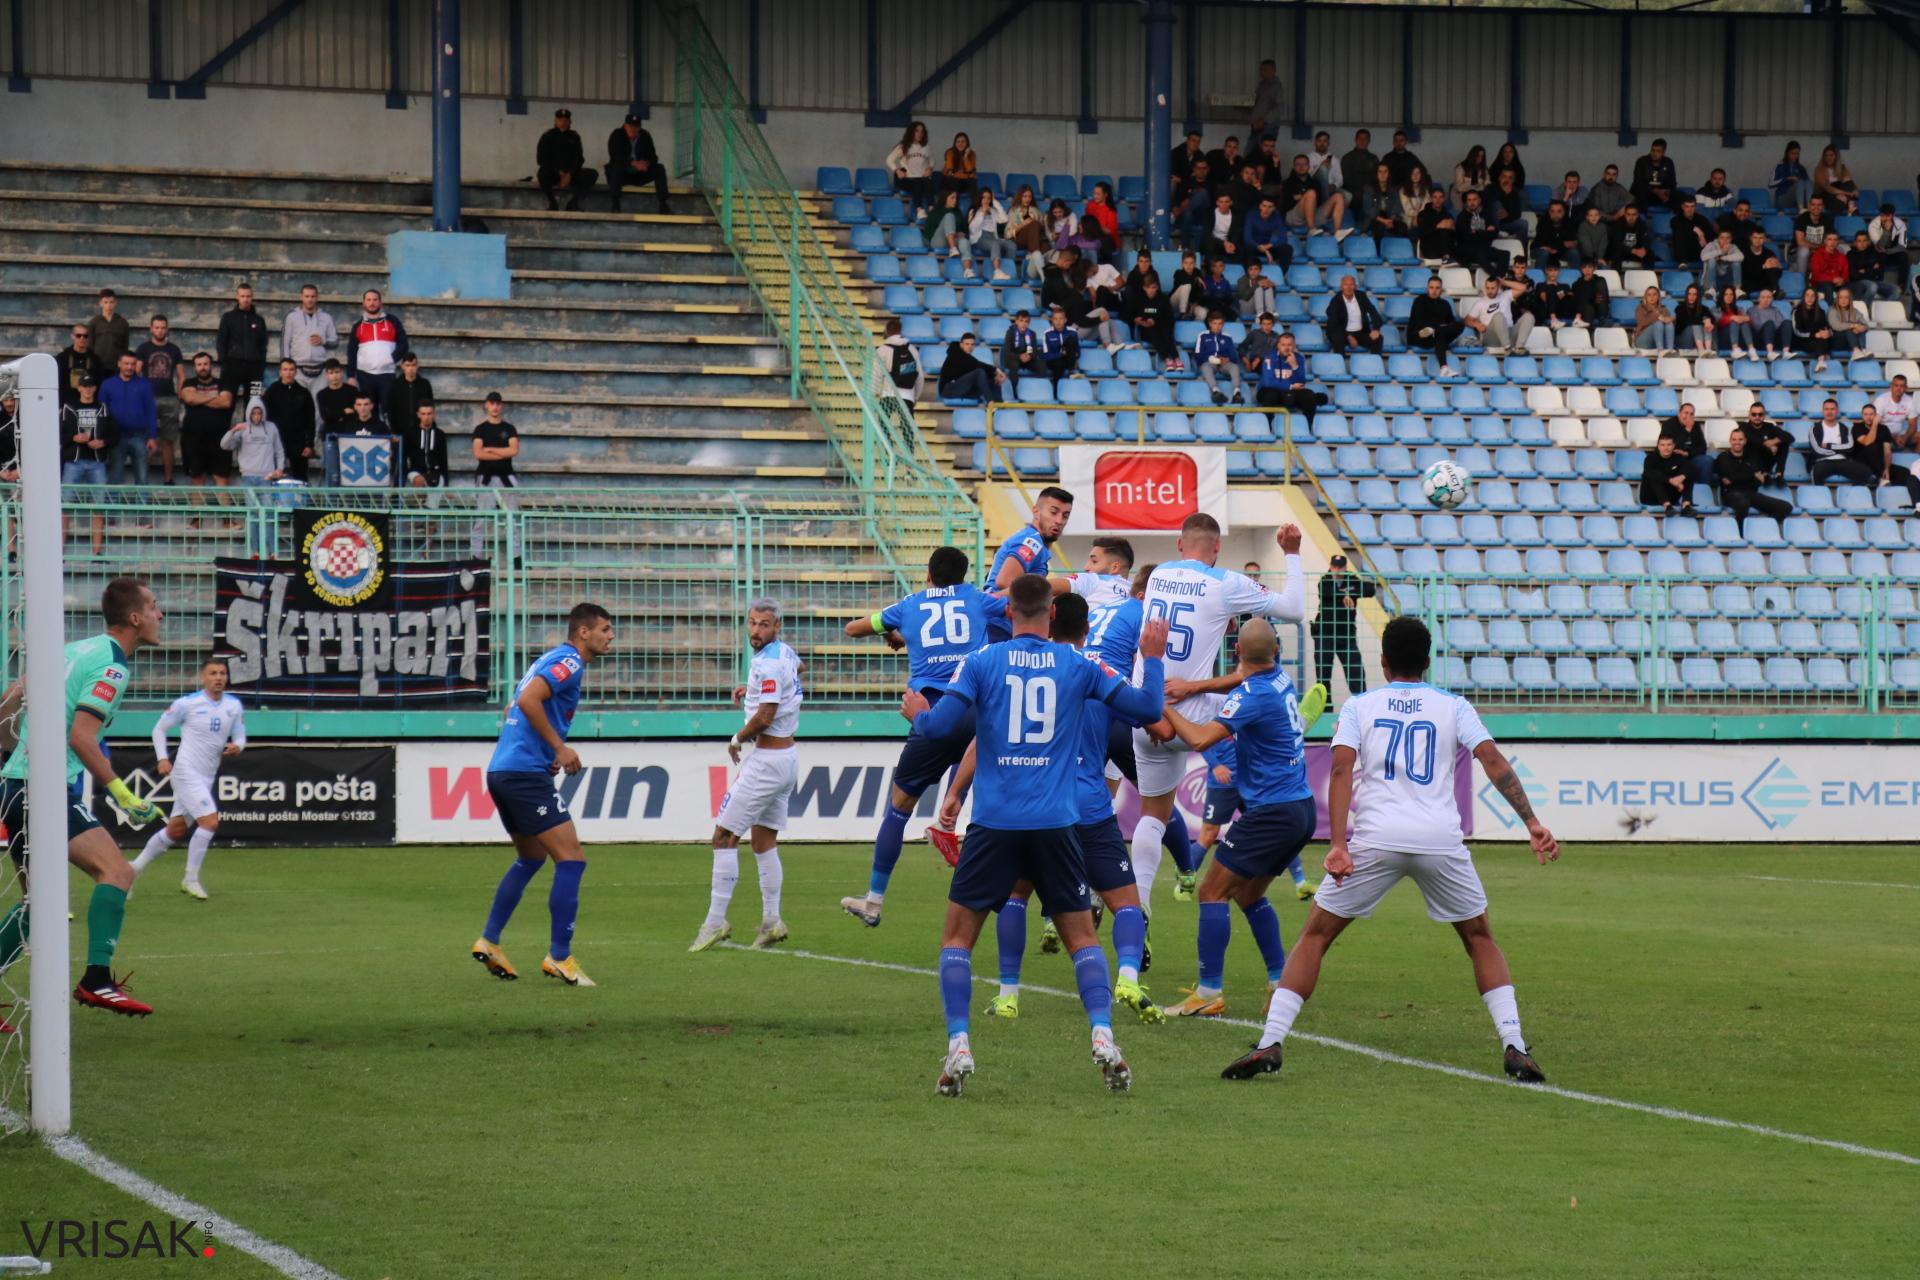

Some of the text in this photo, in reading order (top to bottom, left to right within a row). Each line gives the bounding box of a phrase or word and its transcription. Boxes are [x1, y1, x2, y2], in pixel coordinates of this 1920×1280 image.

[342, 445, 390, 482] 96
[1106, 474, 1184, 504] m:tel
[1150, 577, 1206, 597] MEHANOVIĆ
[920, 600, 969, 647] 26
[1006, 674, 1056, 743] 19
[1388, 698, 1422, 714] KOBIE
[210, 717, 220, 732] 18
[1374, 718, 1436, 785] 70
[218, 774, 376, 807] Brza pošta
[1559, 780, 1734, 806] EMERUS
[218, 811, 265, 821] Hrvatska
[268, 811, 298, 823] pošta
[302, 811, 339, 821] Mostar
